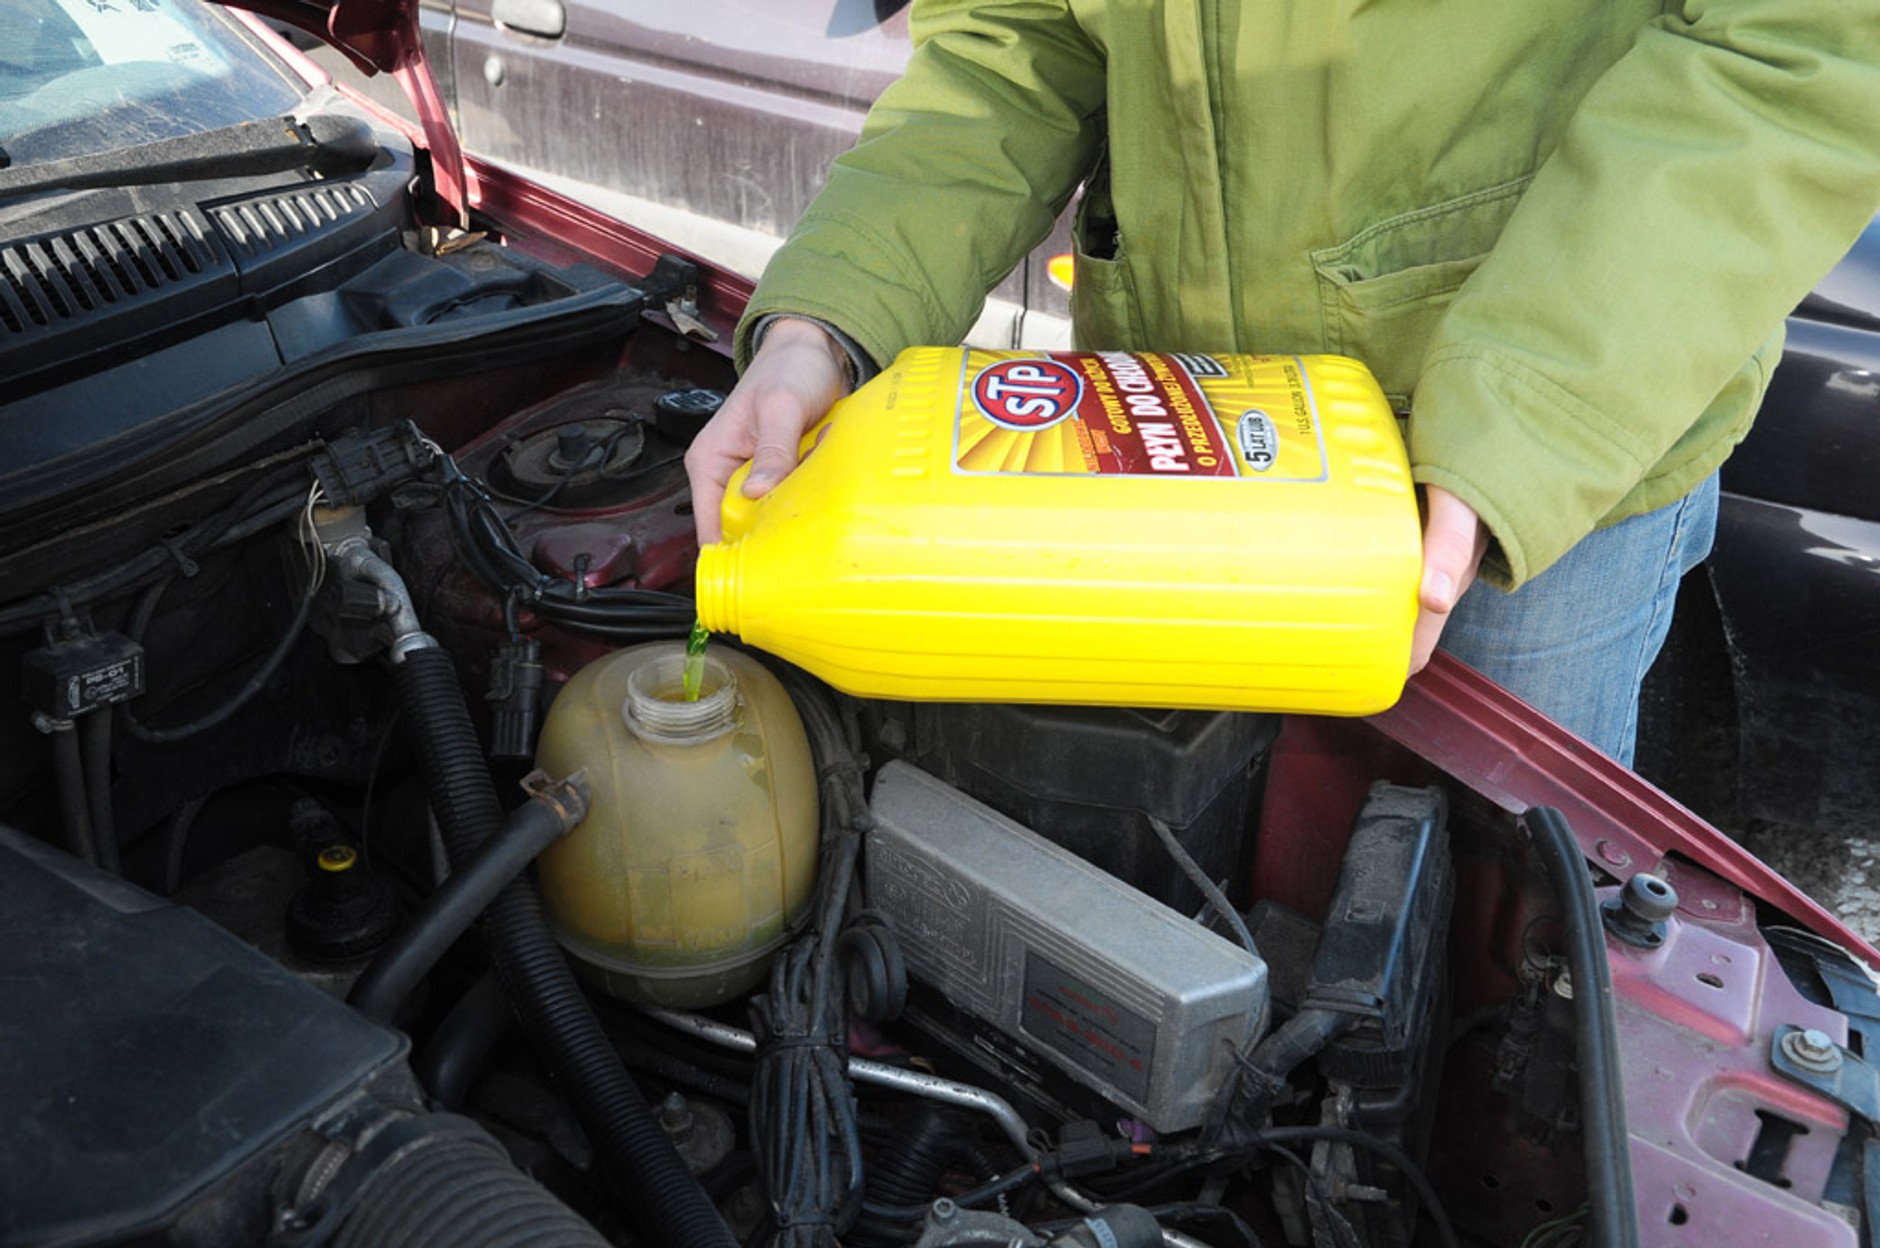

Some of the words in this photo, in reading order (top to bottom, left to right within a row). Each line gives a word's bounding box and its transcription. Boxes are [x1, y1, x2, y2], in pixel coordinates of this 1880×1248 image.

[986, 365, 1064, 418] STP
[1093, 381, 1115, 394] DO
[1099, 394, 1132, 434] GOTOWY
[1125, 394, 1168, 416] DO
[1136, 422, 1190, 471] PŁYN
[1250, 433, 1267, 449] LAT
[1197, 456, 1217, 467] O
[1245, 451, 1272, 462] 5
